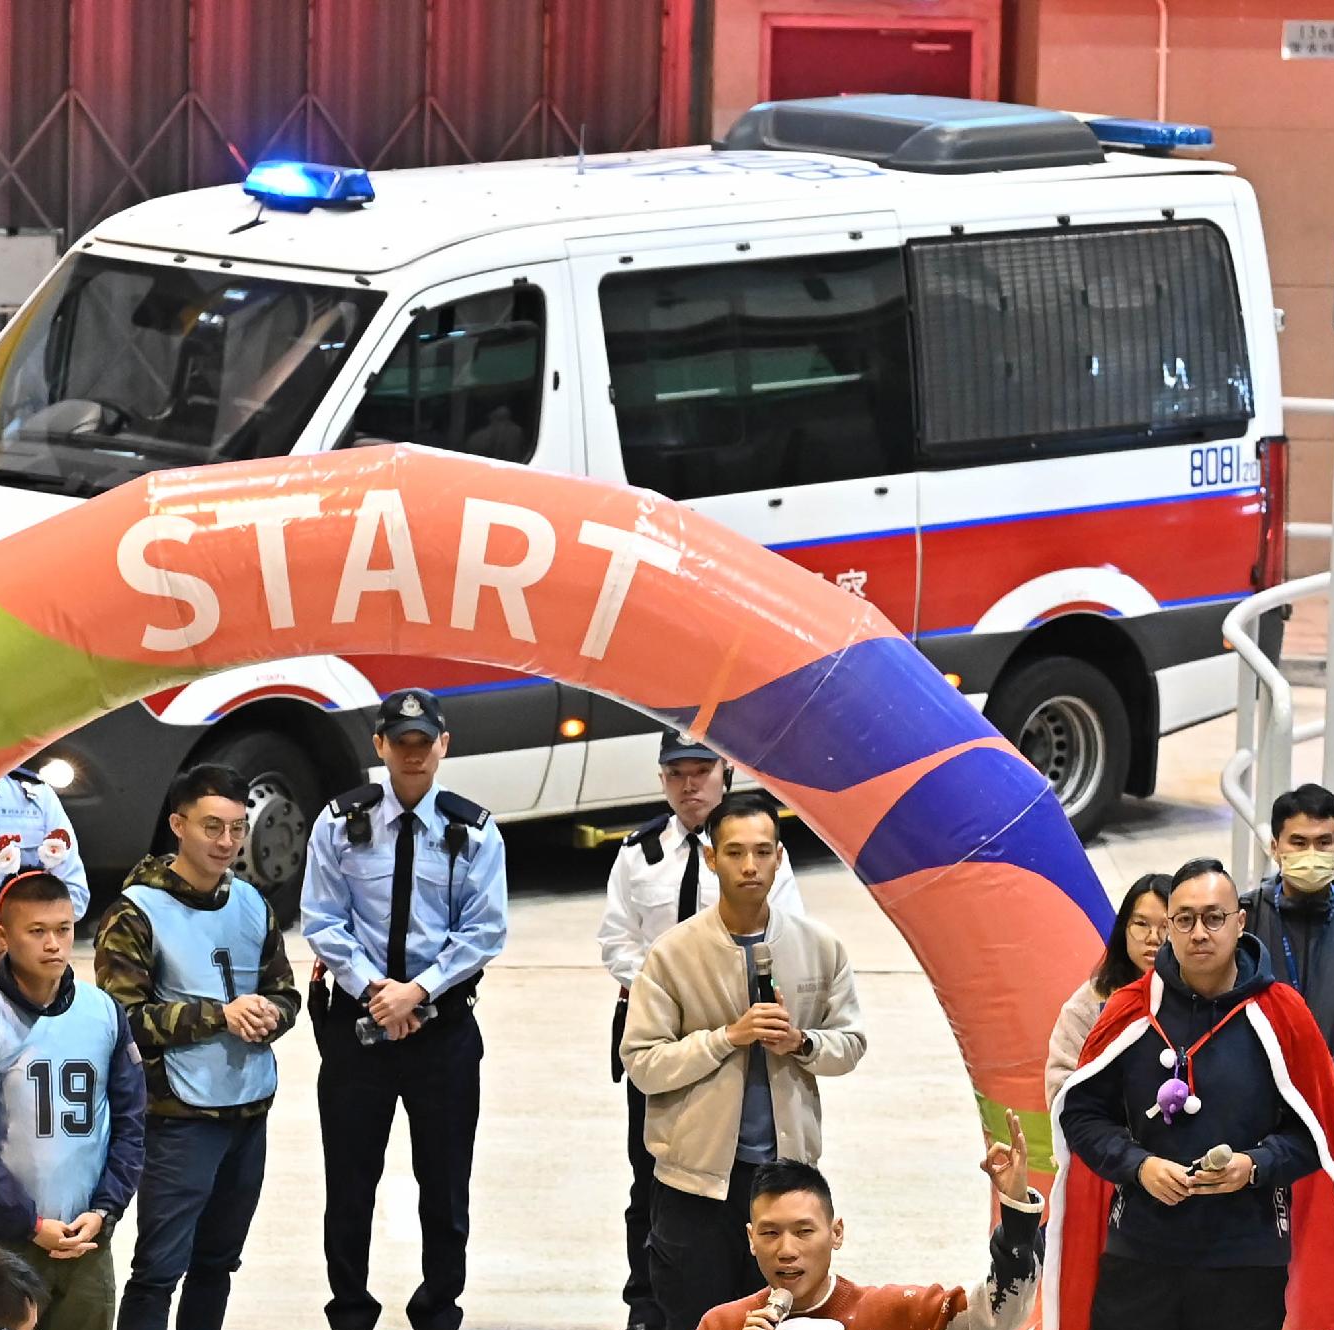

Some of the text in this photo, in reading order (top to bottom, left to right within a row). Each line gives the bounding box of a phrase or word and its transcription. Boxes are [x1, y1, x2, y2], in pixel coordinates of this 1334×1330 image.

[1191, 445, 1240, 487] 8081
[117, 488, 682, 661] START
[817, 568, 867, 599] 察
[27, 1059, 97, 1138] 19
